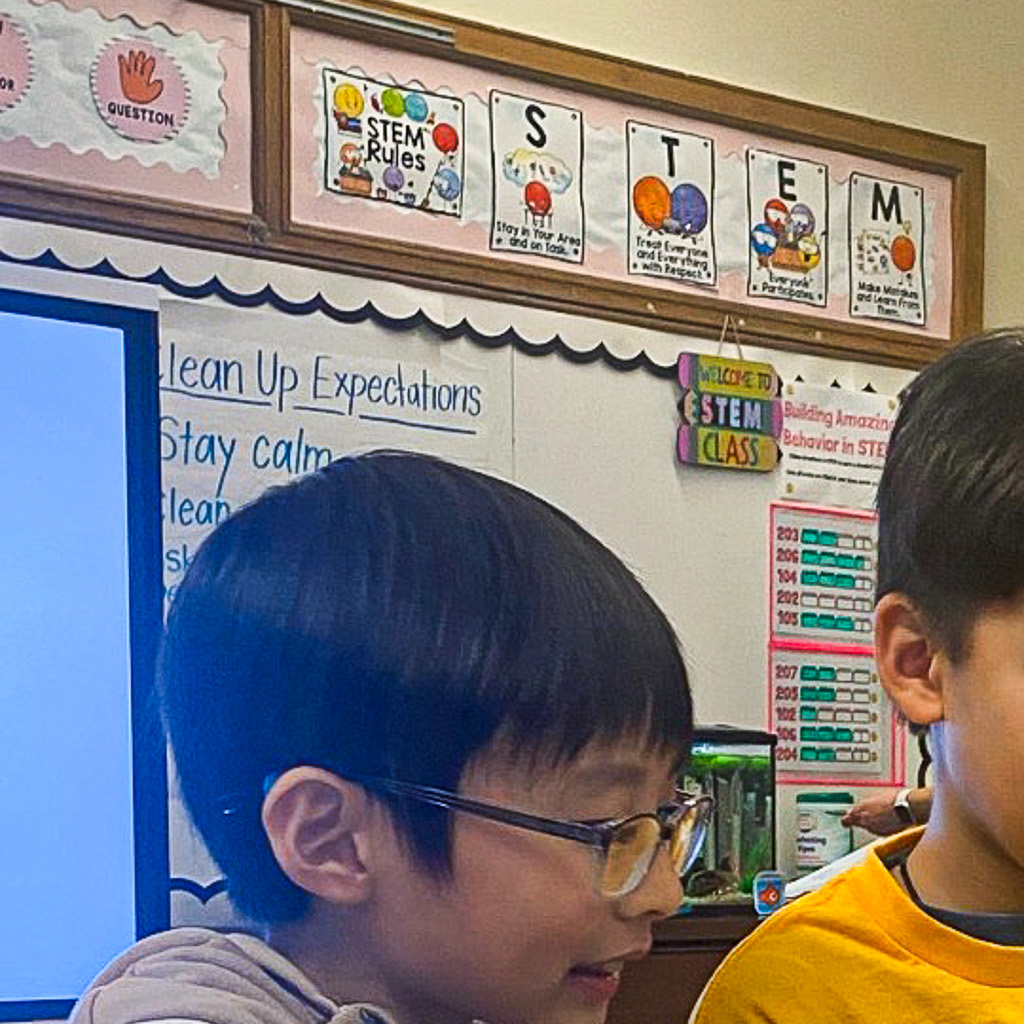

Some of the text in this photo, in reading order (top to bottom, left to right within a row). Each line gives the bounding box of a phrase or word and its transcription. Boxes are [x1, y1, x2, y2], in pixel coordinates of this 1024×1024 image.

[107, 102, 174, 127] QUESTION
[525, 104, 547, 148] S
[367, 117, 425, 150] STEM
[367, 140, 426, 172] Rules
[661, 136, 680, 177] T
[777, 161, 797, 201] E
[872, 183, 902, 225] M
[496, 221, 581, 246] Stay in Your Area
[509, 238, 528, 248] and
[531, 241, 542, 250] on
[636, 250, 655, 260] and
[158, 343, 481, 416] lean Up Expectations
[700, 365, 771, 392] WELCOME TO
[701, 394, 761, 430] STEM
[784, 401, 833, 428] Building
[160, 415, 332, 498] Stay calm
[702, 432, 760, 466] CLASS
[783, 428, 889, 457] Behavior in STE
[160, 487, 231, 526] lean
[777, 526, 799, 543] 203
[777, 589, 799, 606] 202
[775, 664, 798, 680] 207
